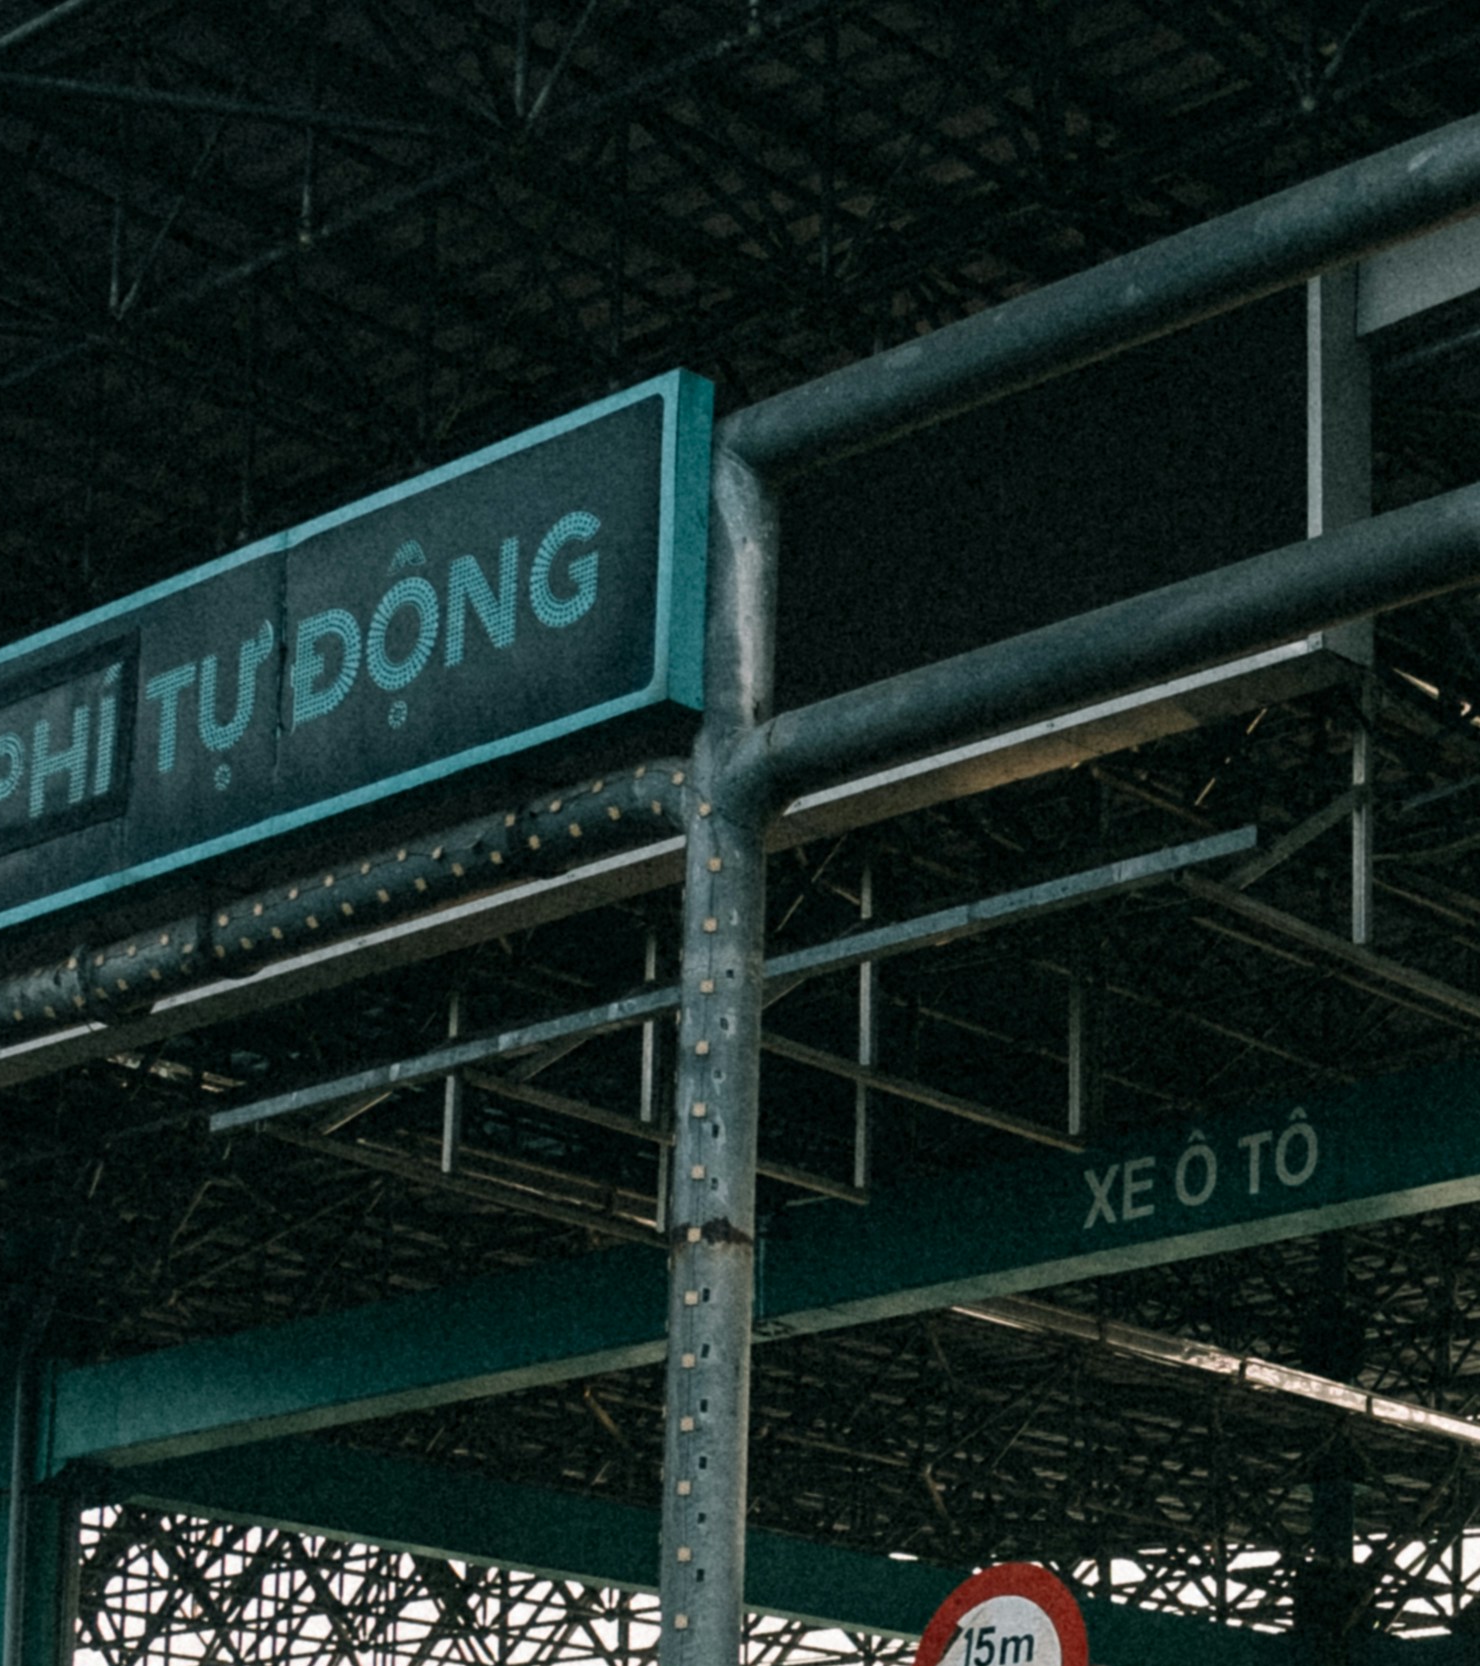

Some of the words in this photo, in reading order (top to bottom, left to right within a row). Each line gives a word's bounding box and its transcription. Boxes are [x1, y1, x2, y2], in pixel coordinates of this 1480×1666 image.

[147, 620, 275, 791] TỰ
[290, 510, 602, 734] ĐỘNG
[1083, 1156, 1156, 1229] XE
[1175, 1129, 1217, 1206] Ô
[1238, 1106, 1318, 1195] TÔ
